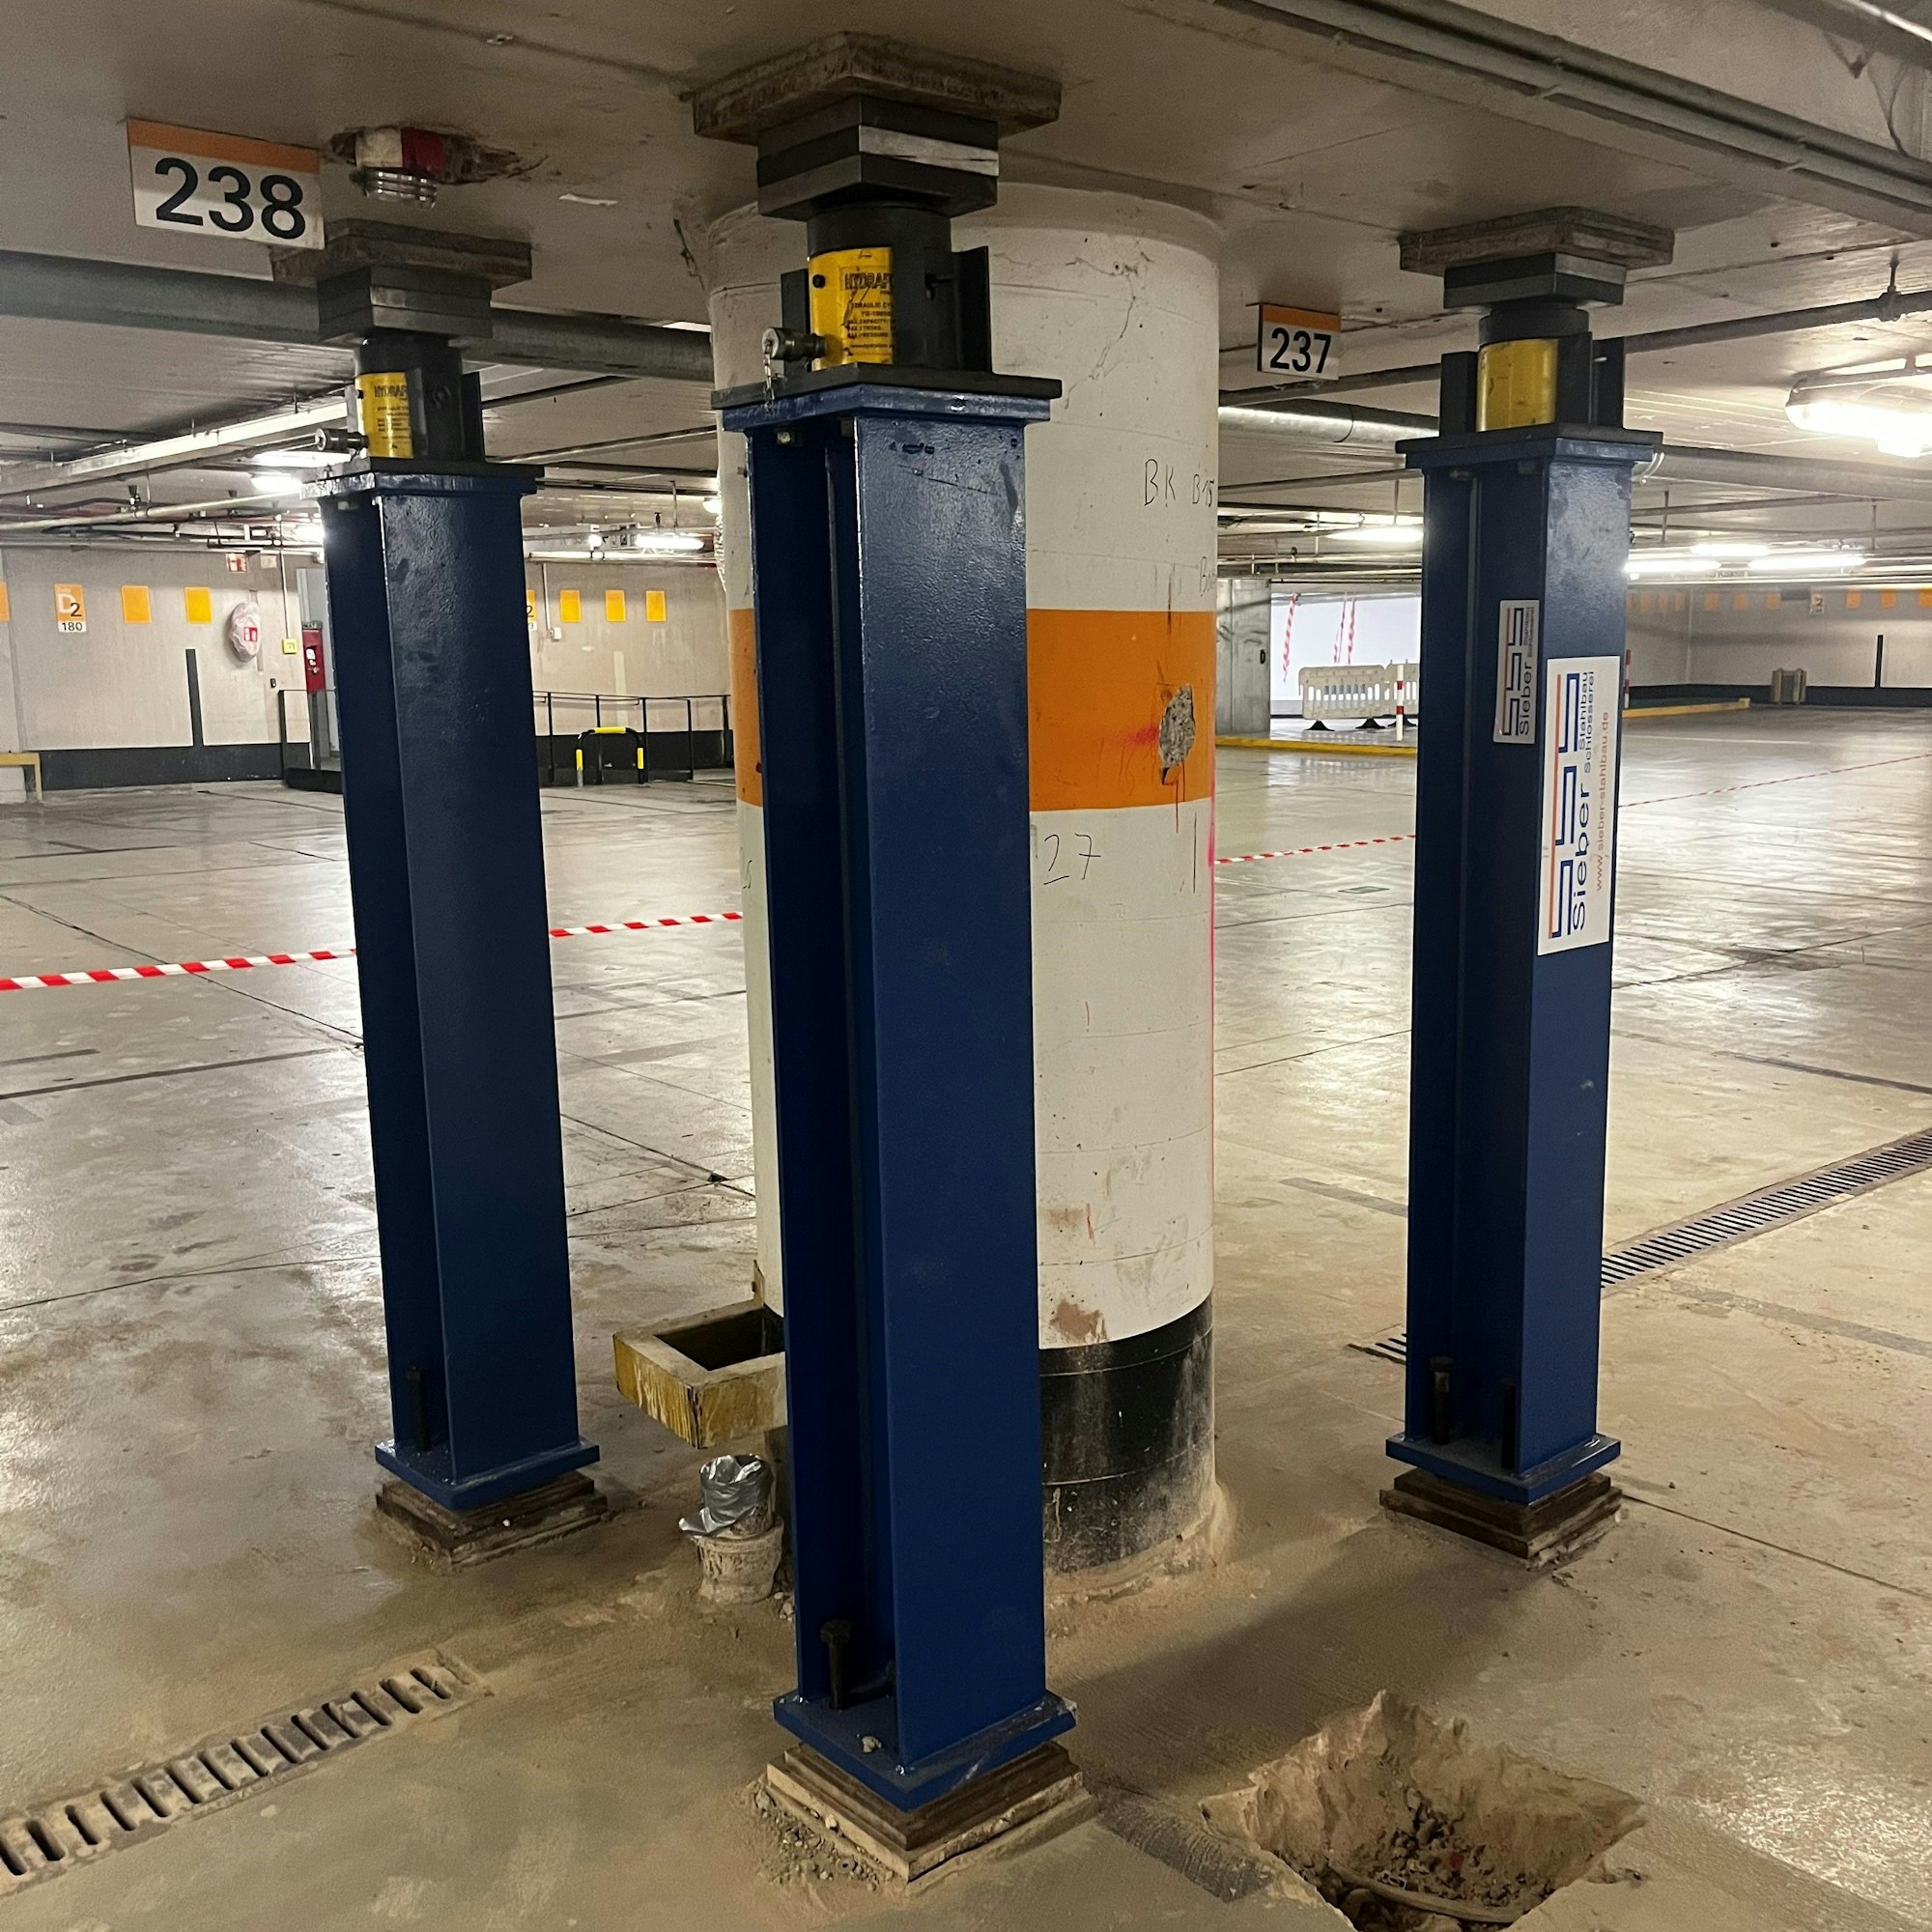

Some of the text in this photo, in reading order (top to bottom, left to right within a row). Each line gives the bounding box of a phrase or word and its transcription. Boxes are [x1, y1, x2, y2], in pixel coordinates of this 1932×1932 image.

[155, 157, 305, 240] 238
[1269, 327, 1332, 374] 237
[61, 621, 83, 632] 180
[1519, 662, 1533, 736] Sieber
[1578, 672, 1588, 751] Stahlbau
[1583, 671, 1595, 774] Schlosserei
[1043, 833, 1101, 886] 27
[1572, 782, 1589, 930] Sieber
